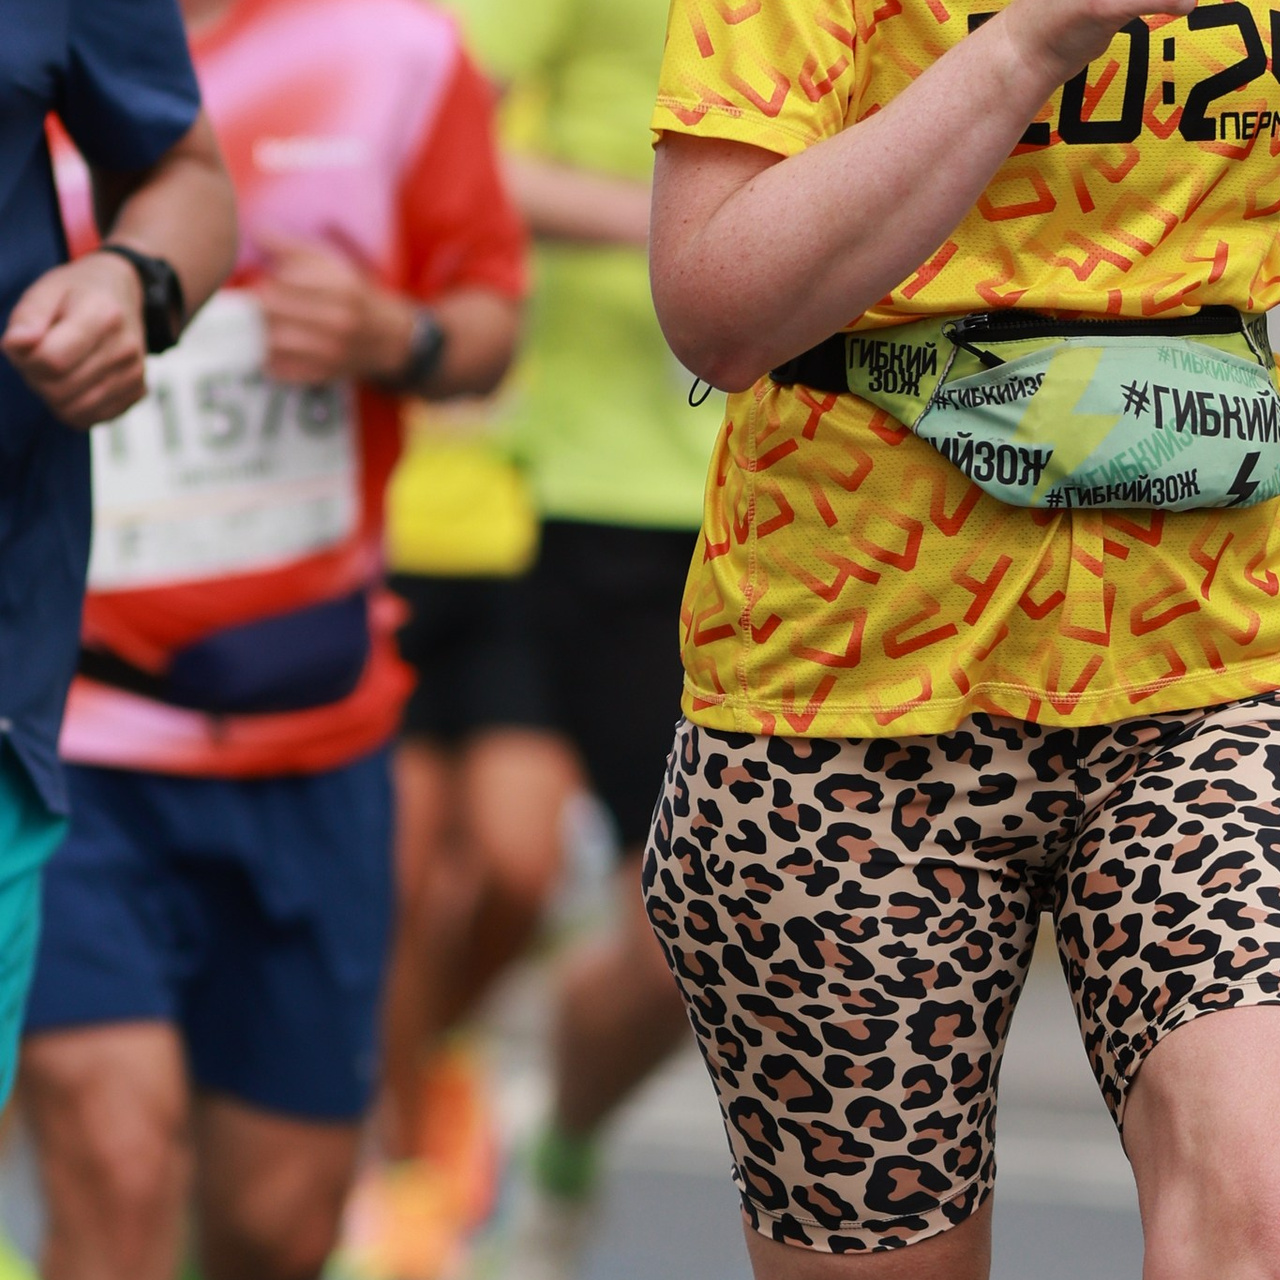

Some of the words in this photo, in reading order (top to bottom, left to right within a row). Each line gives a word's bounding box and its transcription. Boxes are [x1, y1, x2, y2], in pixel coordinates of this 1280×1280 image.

[850, 338, 938, 376] ГИБКИЙ
[868, 368, 923, 397] ЗОЖ
[1045, 468, 1200, 508] #ГИБКИЙЗОЖ
